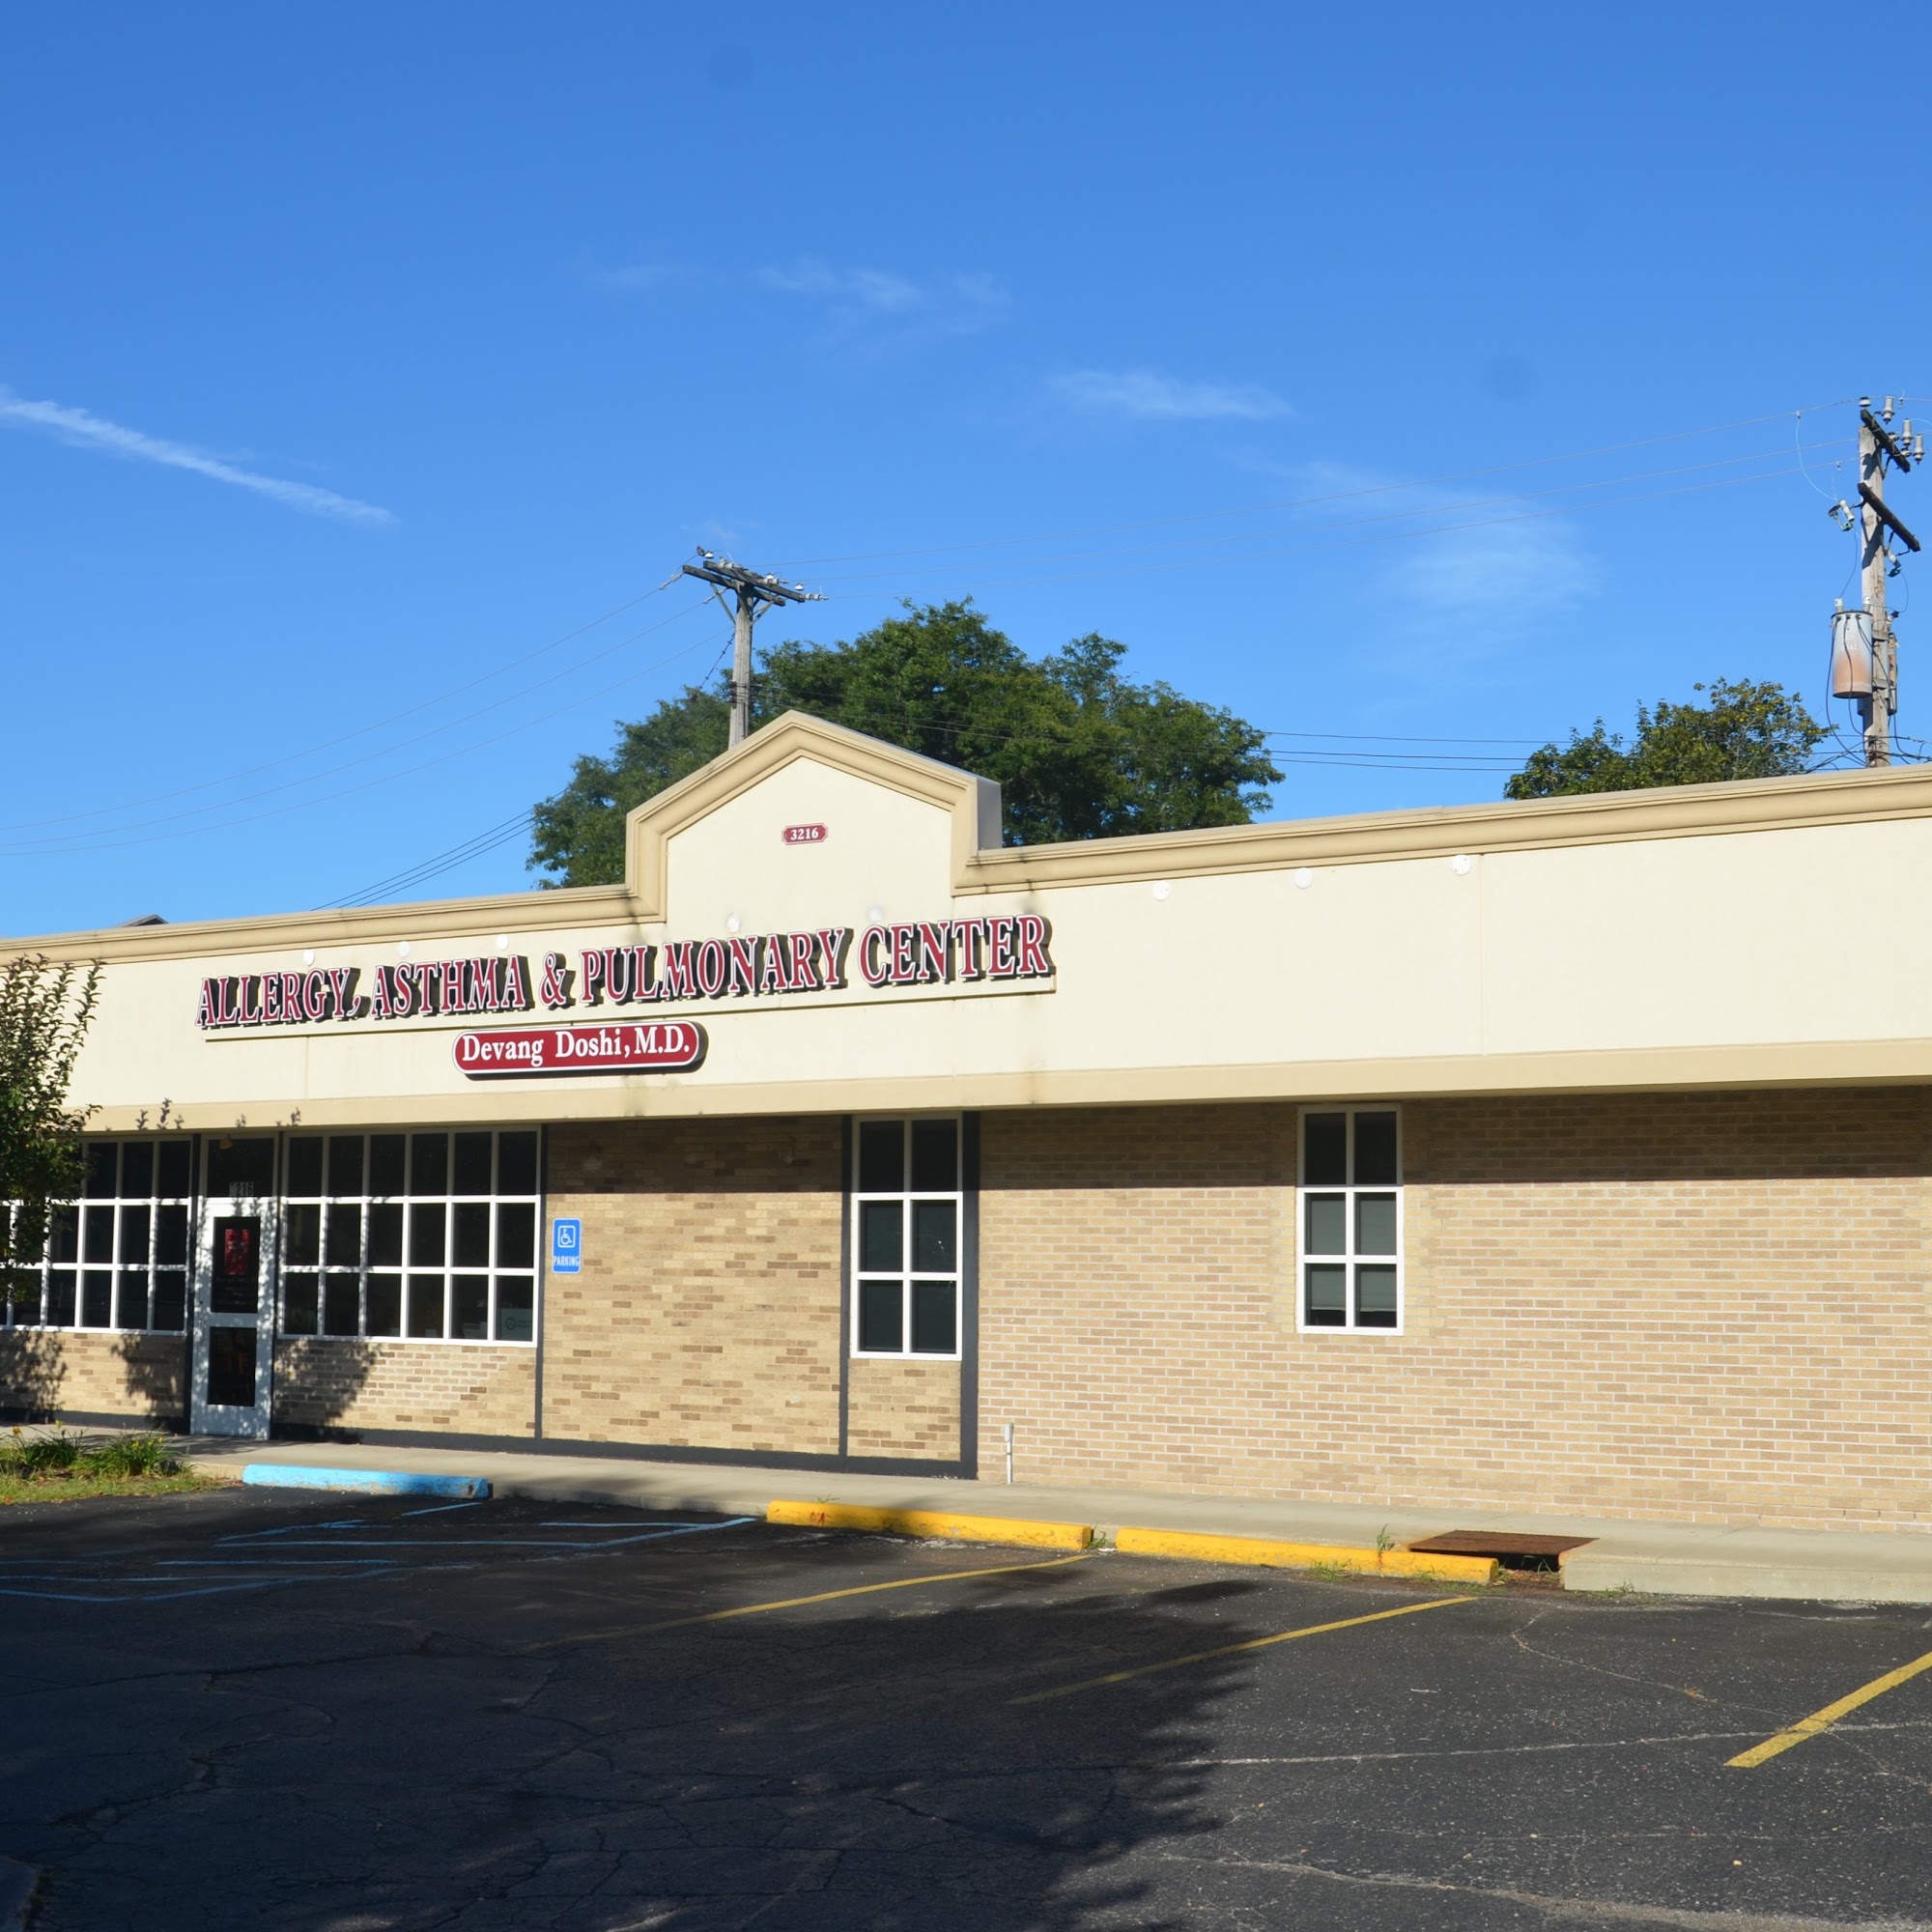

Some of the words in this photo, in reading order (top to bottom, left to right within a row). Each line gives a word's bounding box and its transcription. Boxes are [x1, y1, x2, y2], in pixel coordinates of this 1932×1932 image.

[790, 827, 819, 840] 3216
[195, 967, 362, 1026] ALLERGY,
[370, 954, 526, 1016] ASTHMA
[540, 951, 567, 1007] &
[580, 927, 852, 1005] PULMONARY
[859, 914, 1051, 987] CENTER
[462, 1035, 544, 1067] Devang
[555, 1028, 630, 1058] Doshi,
[634, 1025, 691, 1054] M.D.
[553, 1256, 580, 1266] PARKING
